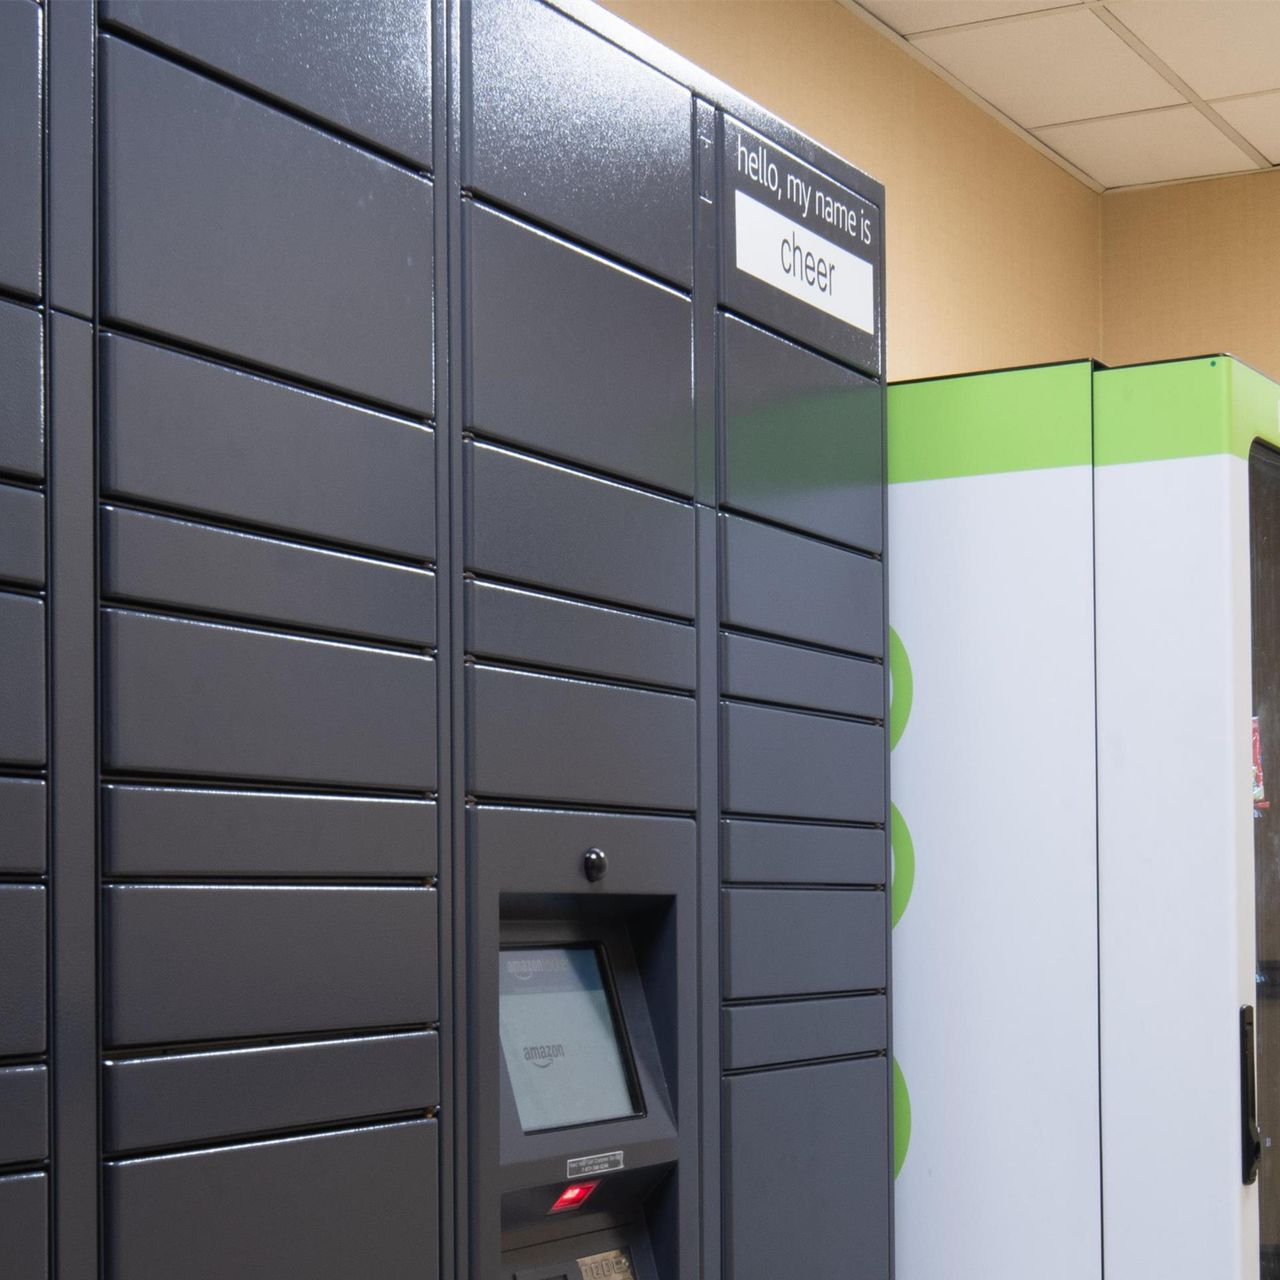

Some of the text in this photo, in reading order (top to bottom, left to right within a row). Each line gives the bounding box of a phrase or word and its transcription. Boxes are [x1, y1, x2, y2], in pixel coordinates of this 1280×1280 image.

[737, 134, 871, 245] hello, my name is
[780, 231, 835, 296] cheer
[523, 1043, 565, 1060] amazon
